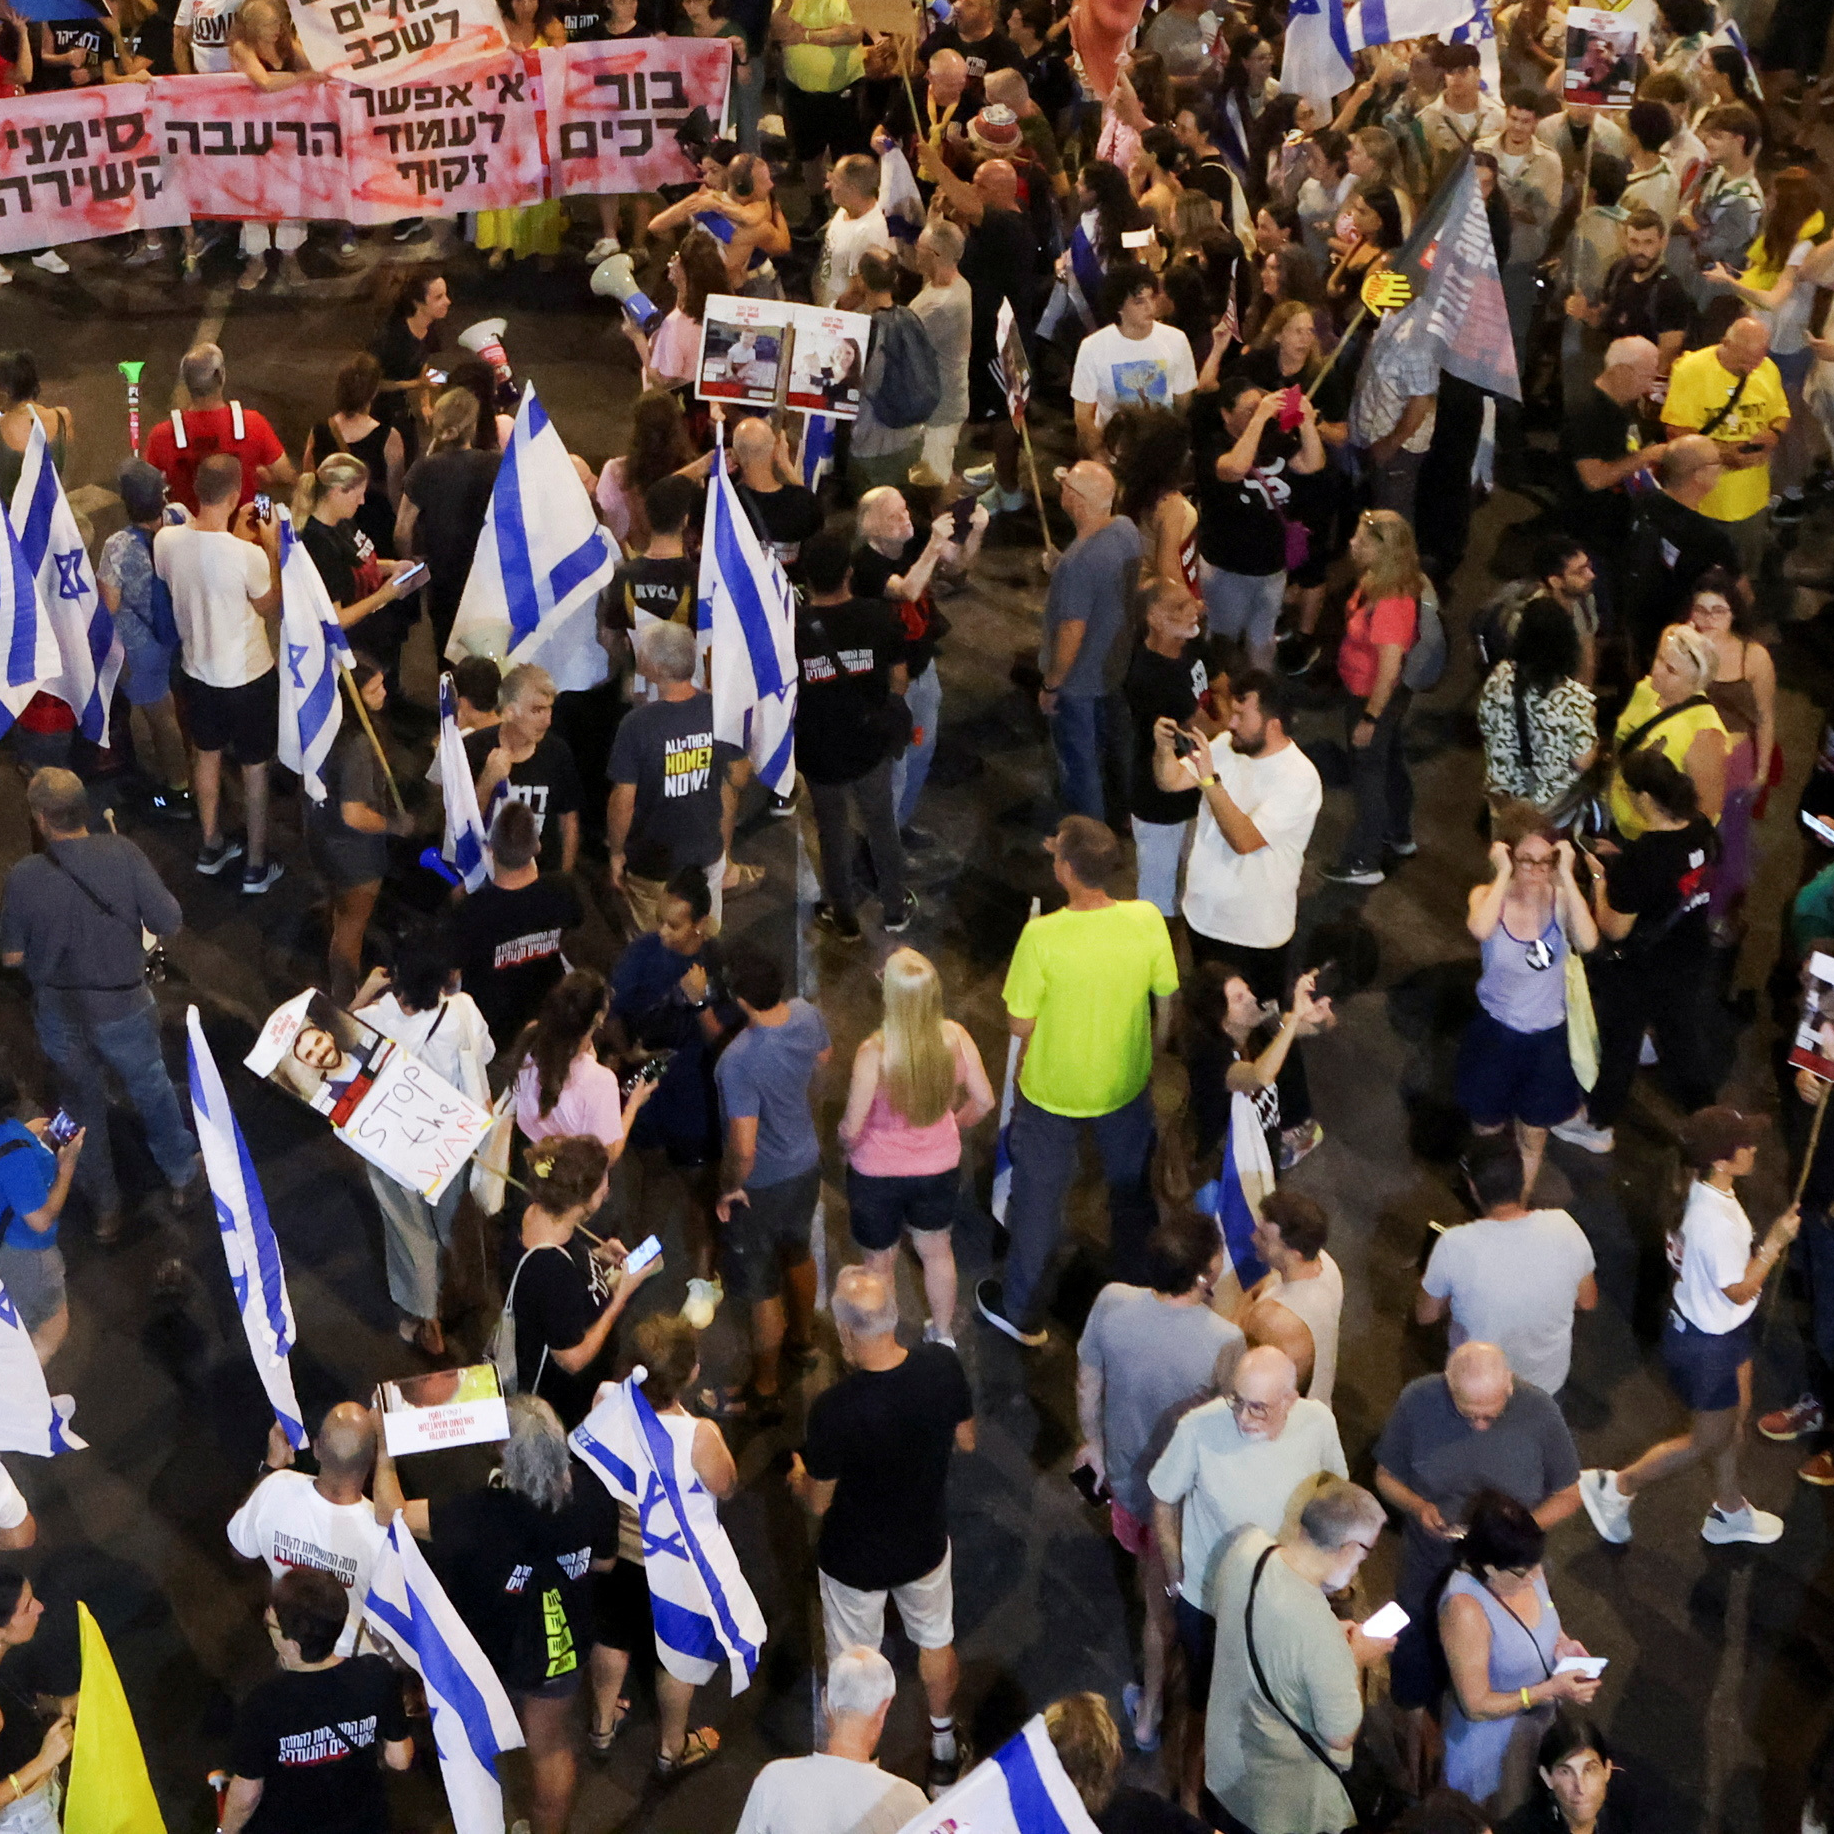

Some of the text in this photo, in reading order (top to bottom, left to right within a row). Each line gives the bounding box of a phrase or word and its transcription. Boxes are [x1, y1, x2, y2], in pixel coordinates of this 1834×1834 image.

[345, 8, 460, 71] לשכב
[350, 73, 525, 118] אי אפשר
[594, 71, 690, 110] בור
[6, 113, 145, 165] סימני
[165, 121, 344, 157] הרעבה
[374, 108, 506, 153] לעמוד
[397, 151, 488, 195] זקוף
[634, 584, 678, 601] RVCA
[665, 732, 713, 754] ALL THEM
[665, 748, 713, 776] HOME!
[664, 769, 710, 799] NOW!
[358, 1065, 430, 1148] STOP
[400, 1101, 459, 1147] the
